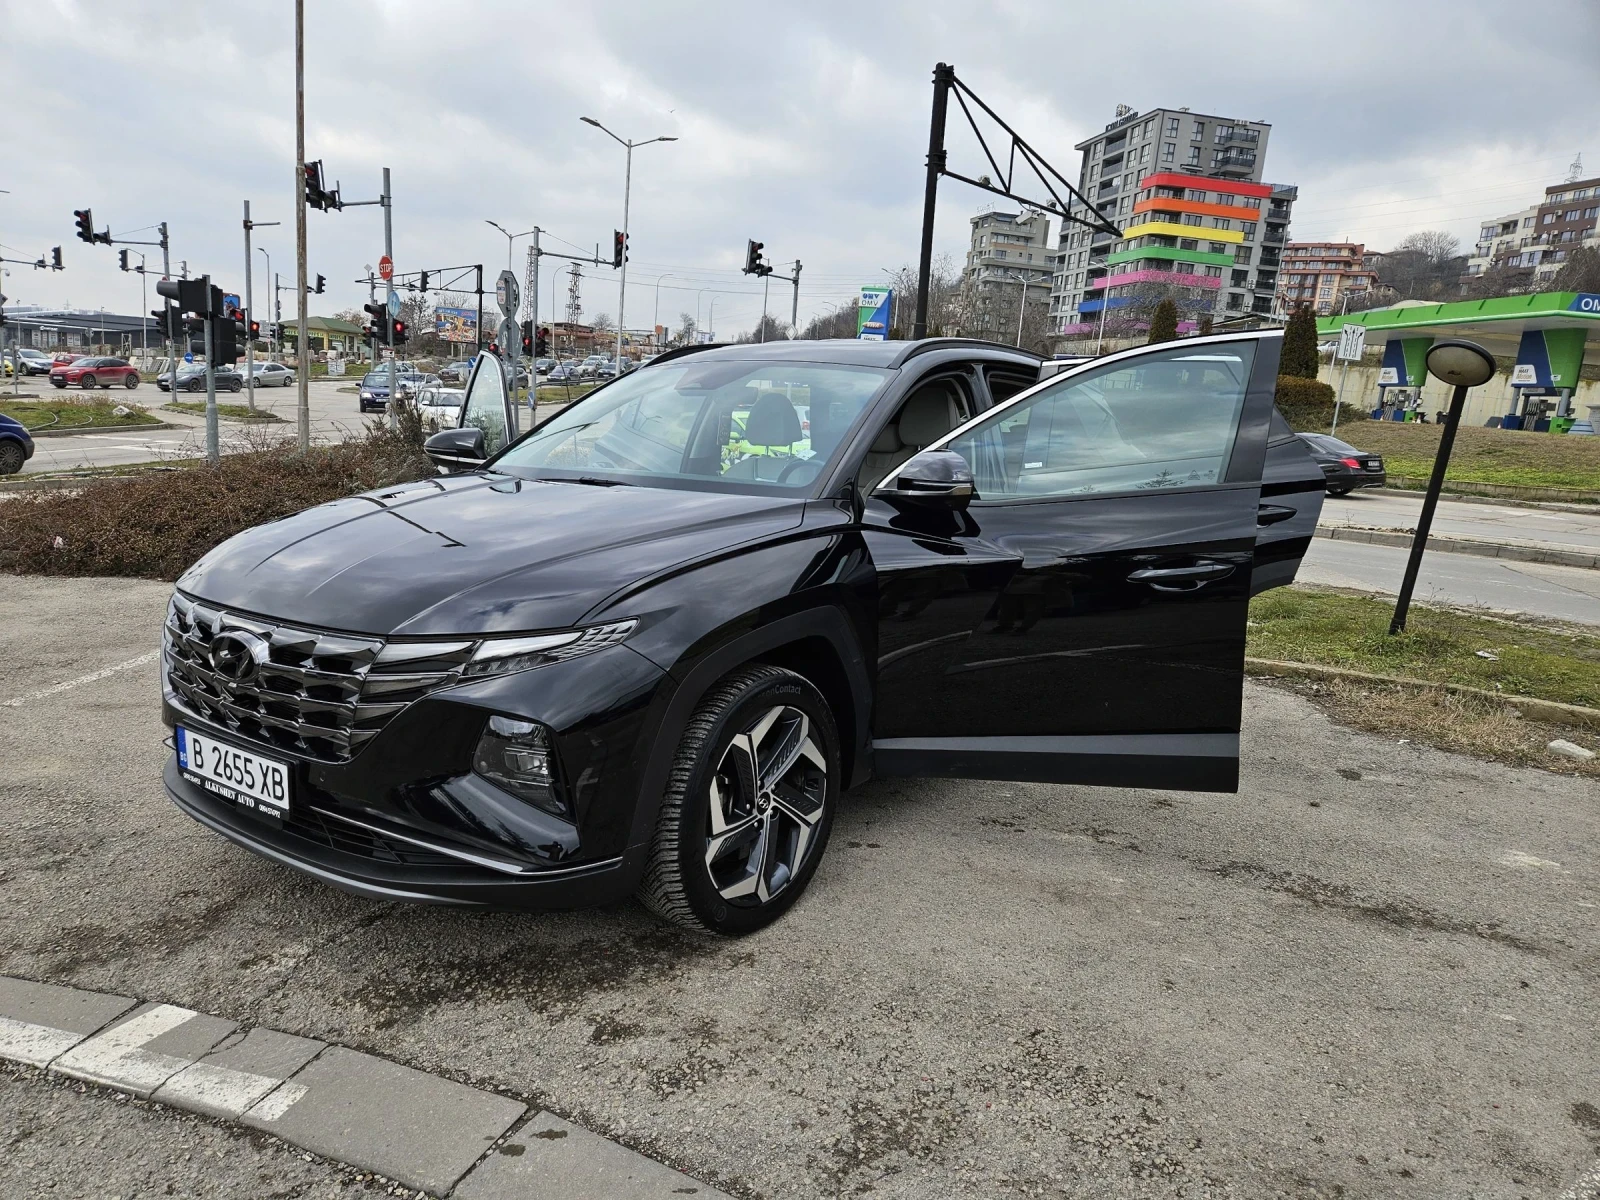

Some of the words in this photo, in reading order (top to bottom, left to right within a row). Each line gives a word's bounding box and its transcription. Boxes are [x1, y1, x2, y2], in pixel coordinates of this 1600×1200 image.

[379, 263, 392, 273] STOP
[180, 751, 187, 762] BG
[193, 737, 204, 769] B
[212, 745, 255, 790] 2655
[259, 762, 285, 801] XB
[204, 780, 237, 800] ALKUSHEV
[237, 793, 255, 808] AUTO
